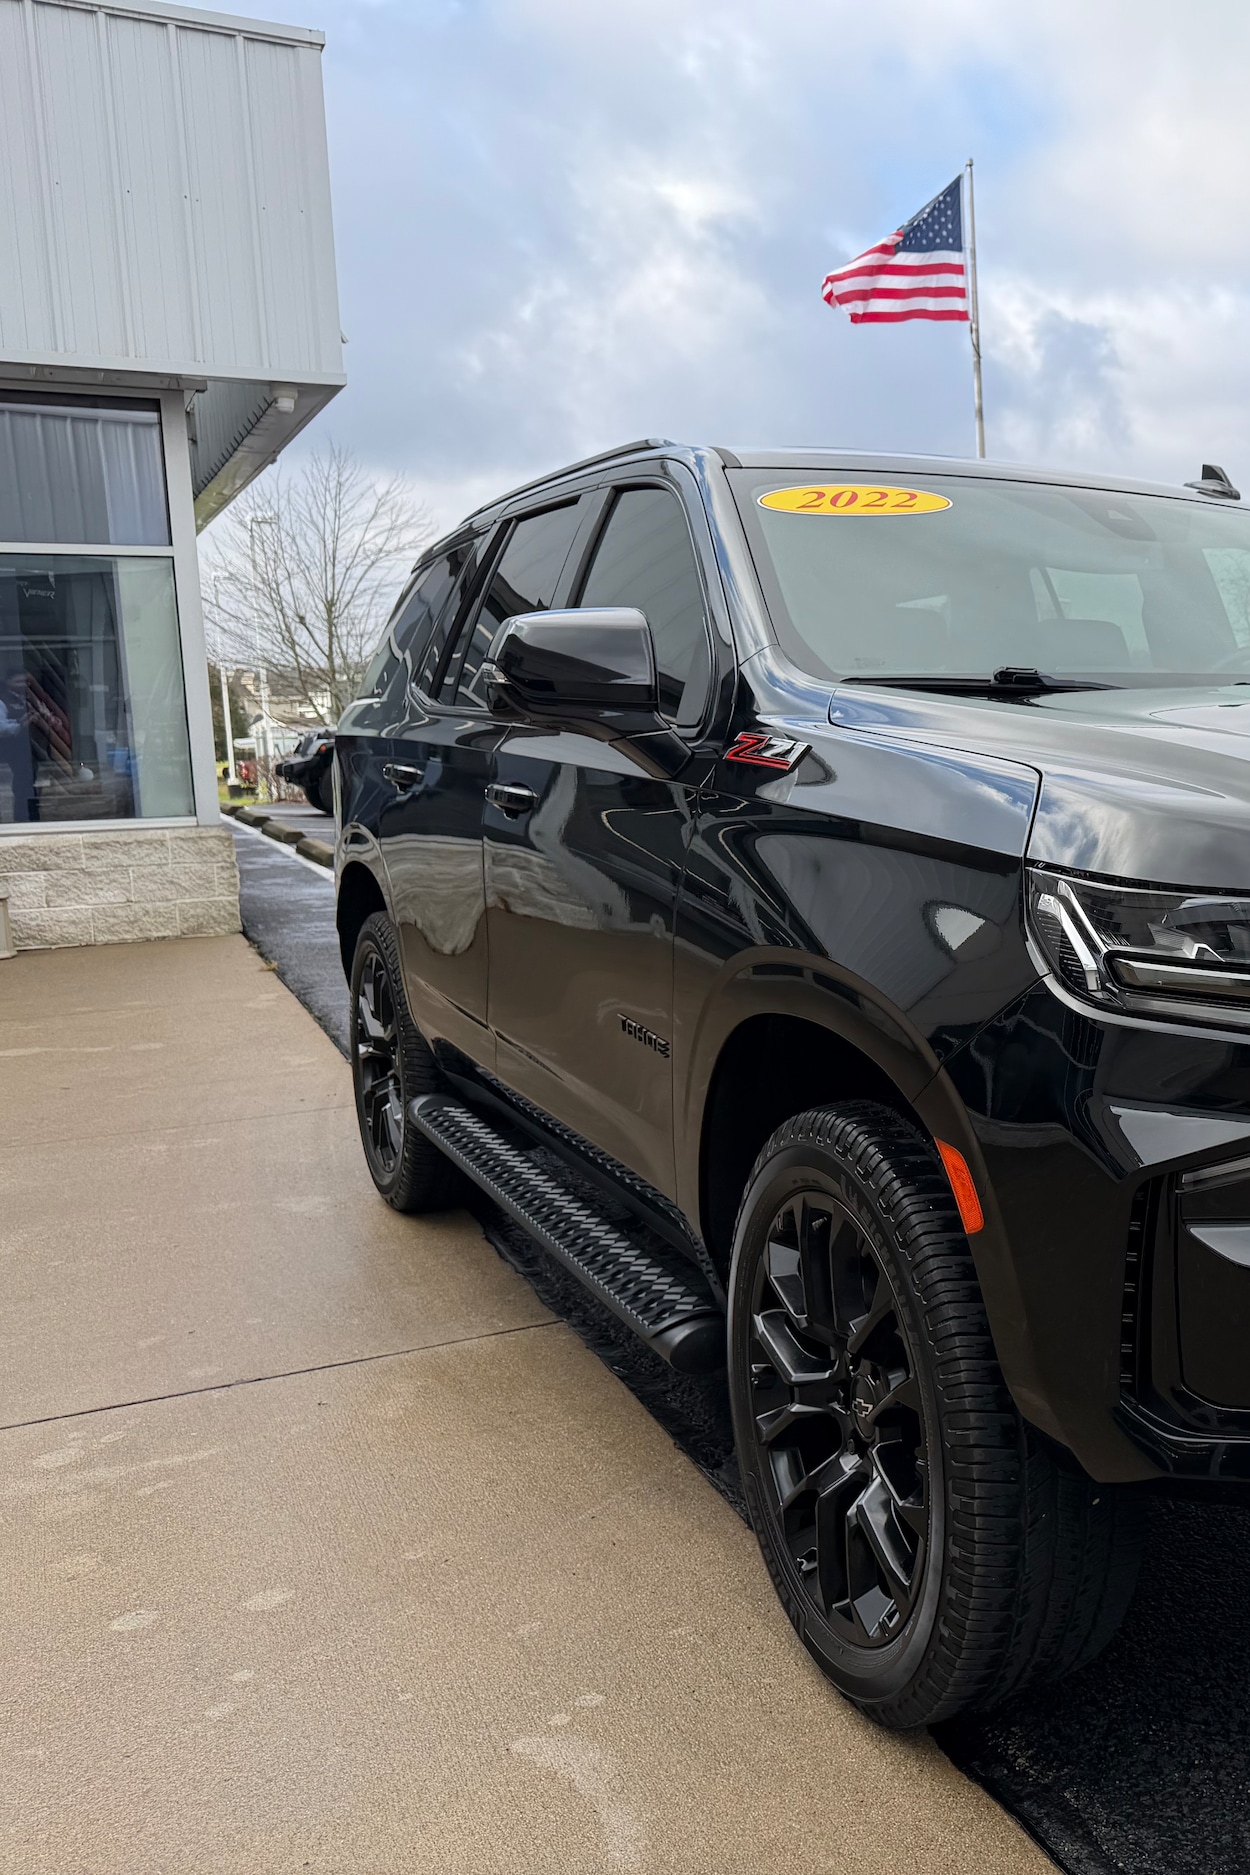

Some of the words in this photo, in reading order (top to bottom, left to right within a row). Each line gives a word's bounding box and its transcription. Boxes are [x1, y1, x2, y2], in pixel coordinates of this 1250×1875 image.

[796, 490, 918, 509] 2022
[723, 731, 812, 771] Z71
[617, 1012, 670, 1058] TAHOE
